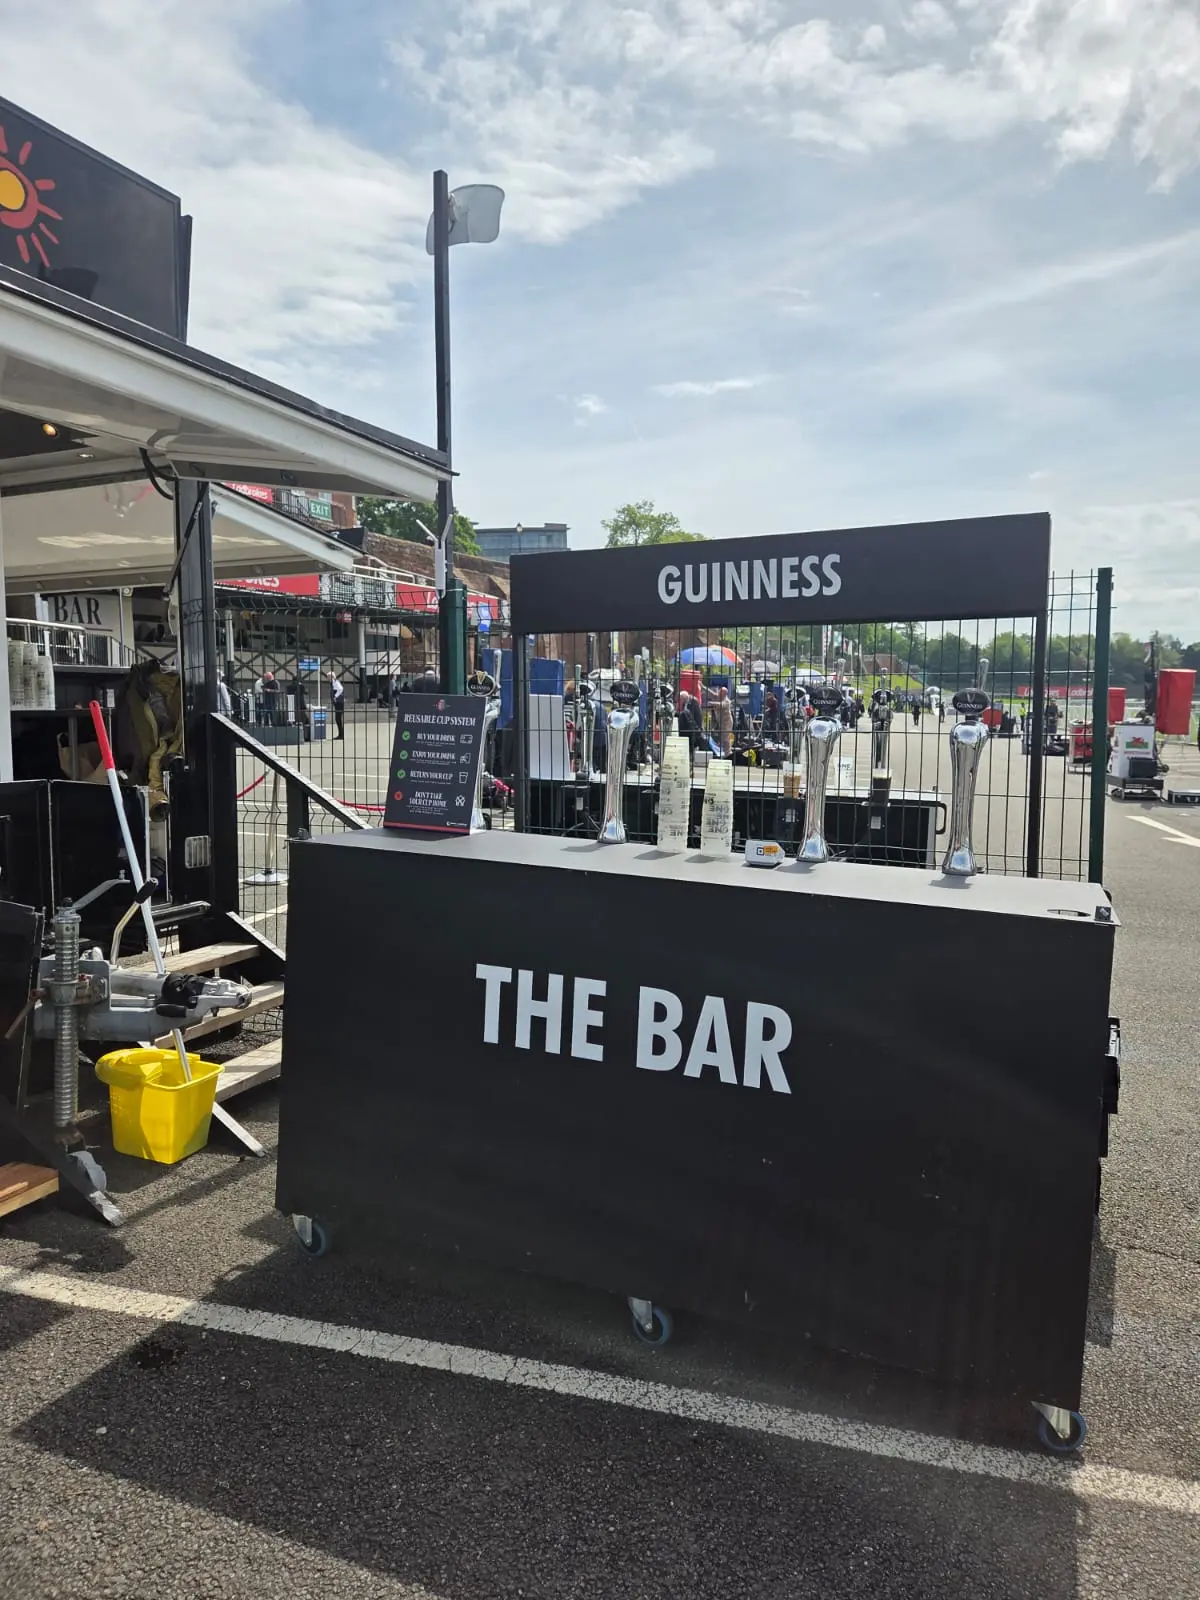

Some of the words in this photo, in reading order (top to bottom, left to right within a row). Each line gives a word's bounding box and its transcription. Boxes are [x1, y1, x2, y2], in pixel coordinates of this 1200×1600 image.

[310, 502, 330, 516] EXIT
[657, 553, 842, 605] GUINNESS
[54, 595, 102, 625] BAR
[404, 713, 436, 724] REUSABLE
[436, 715, 450, 725] CUP
[450, 716, 476, 727] SYSTEM
[475, 963, 607, 1061] THE
[636, 985, 793, 1094] BAR
